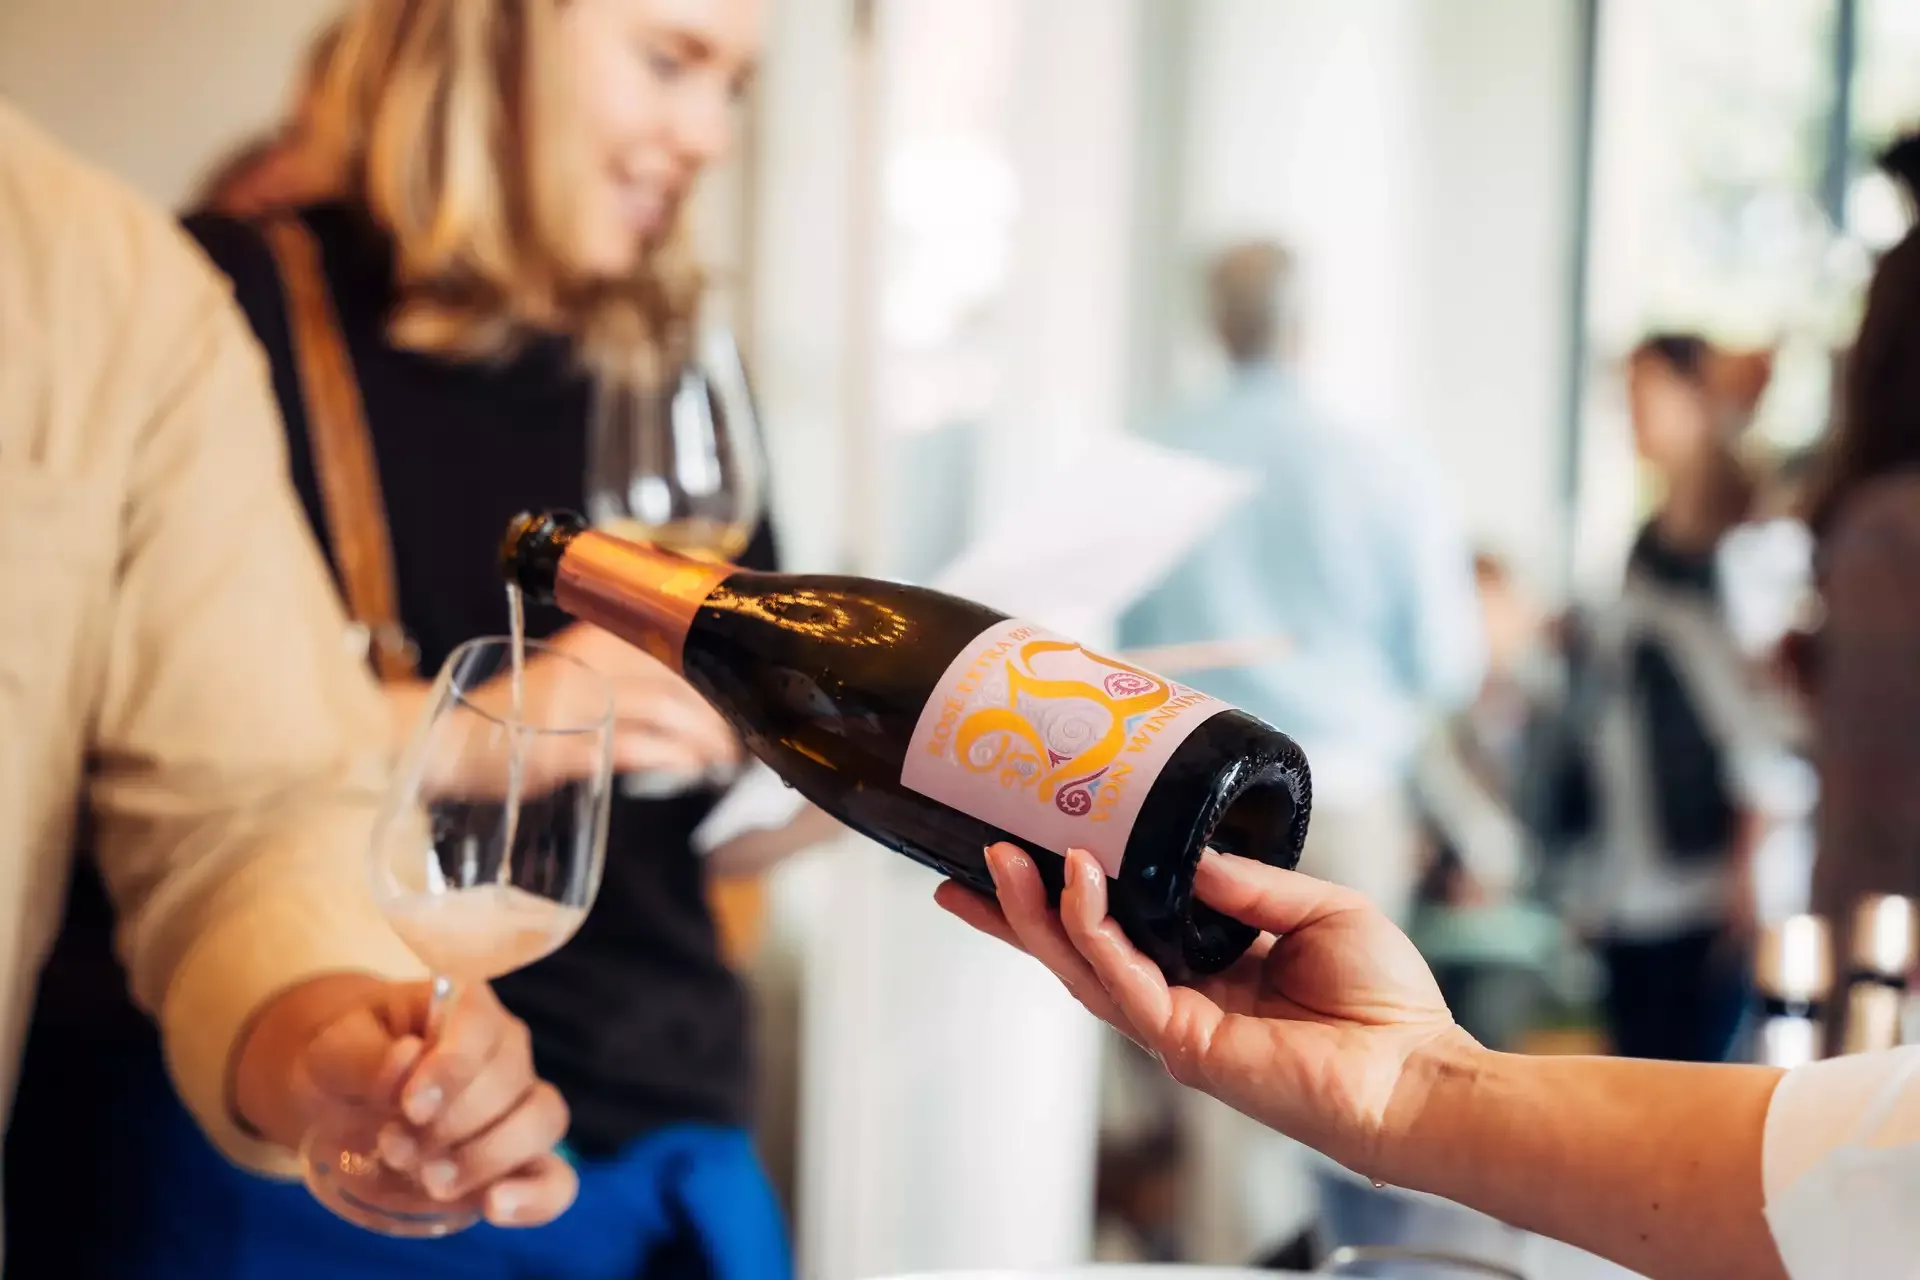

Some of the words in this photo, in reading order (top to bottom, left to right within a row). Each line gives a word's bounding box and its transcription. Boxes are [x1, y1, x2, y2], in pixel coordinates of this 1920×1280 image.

[956, 640, 1014, 695] EXTRA
[1089, 760, 1134, 822] VON
[1124, 692, 1209, 753] WINNIN
